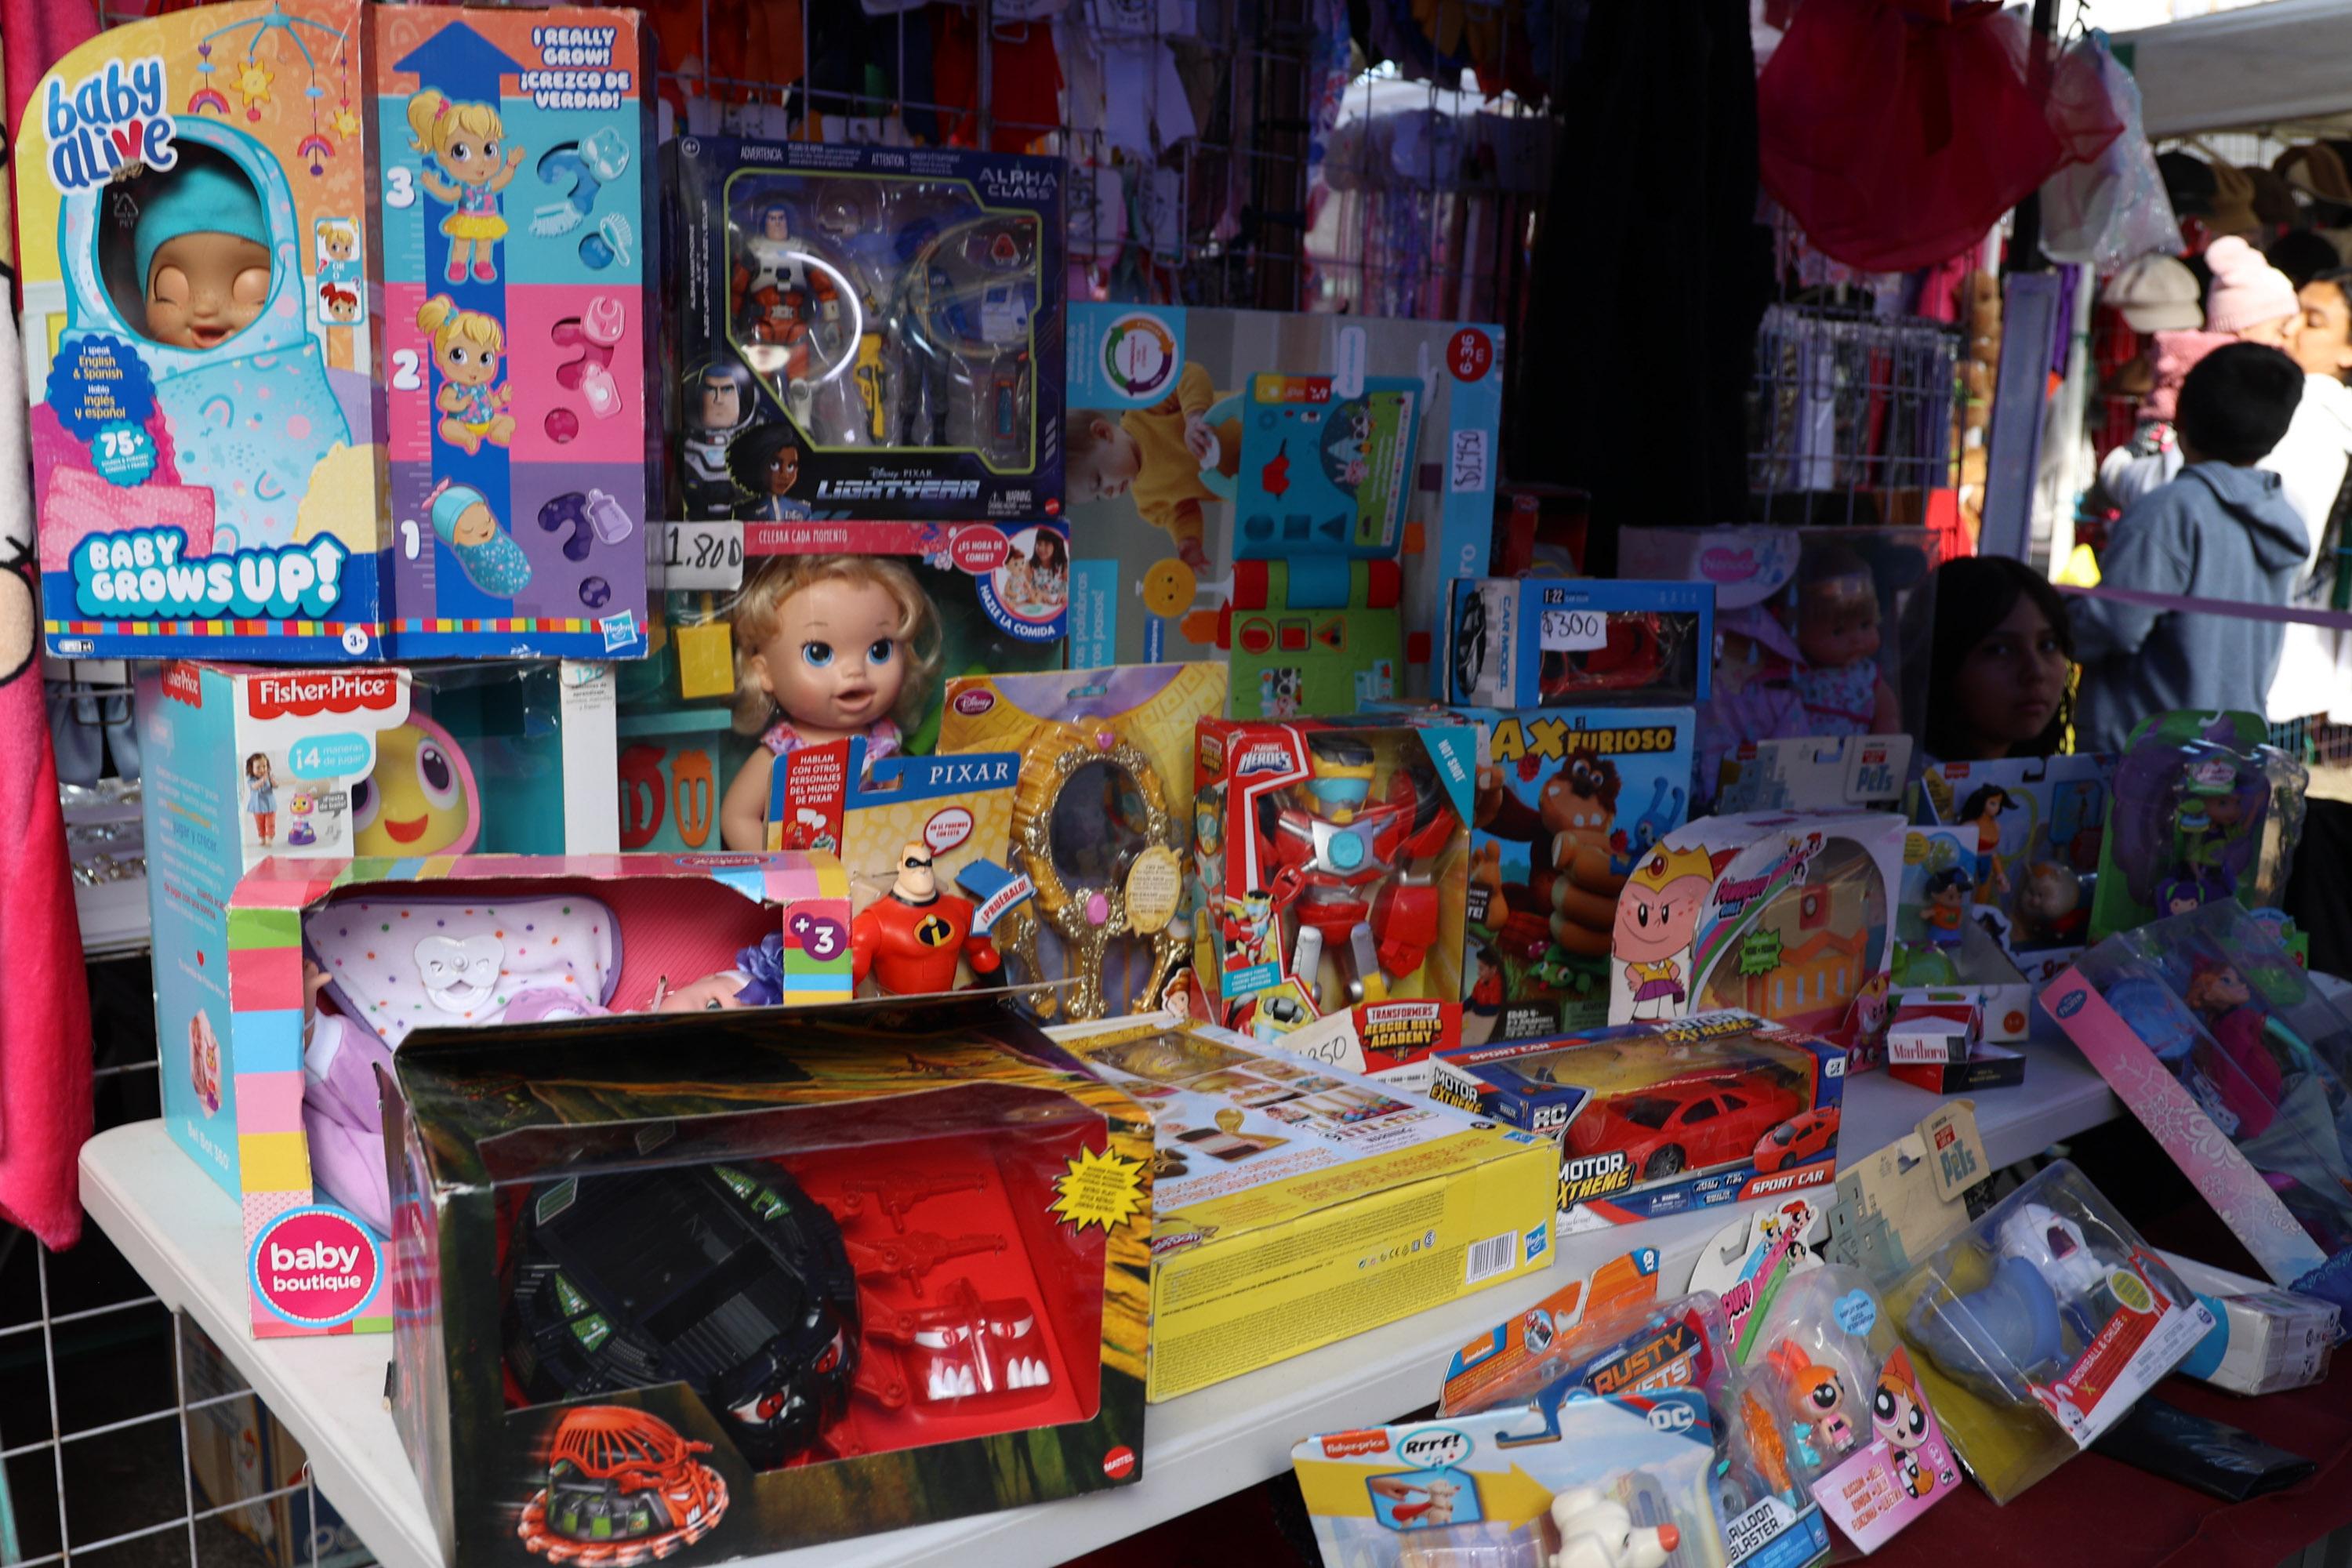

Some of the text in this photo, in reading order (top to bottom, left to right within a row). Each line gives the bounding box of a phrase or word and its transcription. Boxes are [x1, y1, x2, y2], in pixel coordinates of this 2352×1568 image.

[533, 27, 615, 47] I REALLY
[543, 47, 610, 67] GROW!
[521, 71, 630, 92] ¡CREZCO DE
[48, 61, 162, 140] baby
[535, 89, 619, 110] VERDAD!
[979, 166, 1058, 187] ALPHA
[387, 166, 416, 209] 3
[987, 183, 1051, 200] CLASS
[79, 355, 116, 368] English
[88, 346, 111, 356] speak
[84, 368, 123, 380] Spanish
[392, 349, 420, 390] 2
[88, 384, 110, 394] Hablo
[74, 406, 125, 420] y español
[100, 430, 144, 459] 75+
[903, 469, 932, 478] PIXAR
[401, 520, 420, 559] 1
[759, 528, 848, 544] CELEBRA CADA MOMENTO
[971, 540, 992, 550] HORA
[993, 540, 1003, 550] DE
[89, 535, 179, 570] BABY
[965, 553, 994, 563] COMER?
[92, 539, 343, 604] GROWS UP!
[980, 584, 1055, 637] HAZLE LA COMIDA
[1541, 612, 1599, 637] $300
[1500, 596, 1512, 692] CAR MODEL
[960, 694, 994, 709] Disney
[322, 744, 364, 754] maneras
[1490, 715, 1570, 763] AX
[1568, 728, 1673, 753] FURIOSO
[323, 753, 365, 767] de jugar!
[793, 764, 840, 775] CON OTROS
[800, 754, 834, 764] HABLAN
[1238, 751, 1292, 773] HEROES
[1438, 738, 1466, 783] HOT SHOT
[789, 773, 841, 786] PERSONAJES
[928, 762, 1009, 786] PIXAR
[789, 783, 840, 796] DEL MUNDO
[795, 793, 833, 805] DE PIXAR
[1372, 1006, 1434, 1020] TRANSFORMERS
[1364, 1018, 1443, 1036] RESCUE BOTS
[1370, 1029, 1434, 1049] ACADEMY
[1893, 1038, 1947, 1060] Marlboro
[1468, 1043, 1552, 1062] SPORT CAR
[1434, 1067, 1479, 1104] MOTOR
[1533, 1102, 1567, 1130] RC
[1558, 1152, 1624, 1180] MOTOR
[1555, 1167, 1632, 1208] XTREME
[1751, 1169, 1825, 1195] SPORT CAR
[270, 1242, 360, 1273] baby
[273, 1272, 362, 1293] boutique
[1593, 1326, 1684, 1396] RUSTY
[2068, 1317, 2125, 1387] SNOWBALL & CHLOE
[1653, 1409, 1690, 1428] DC
[1405, 1433, 1463, 1454] Rrrf!
[1103, 1452, 1135, 1473] MATTEL
[1730, 1517, 1779, 1561] BLASTER
